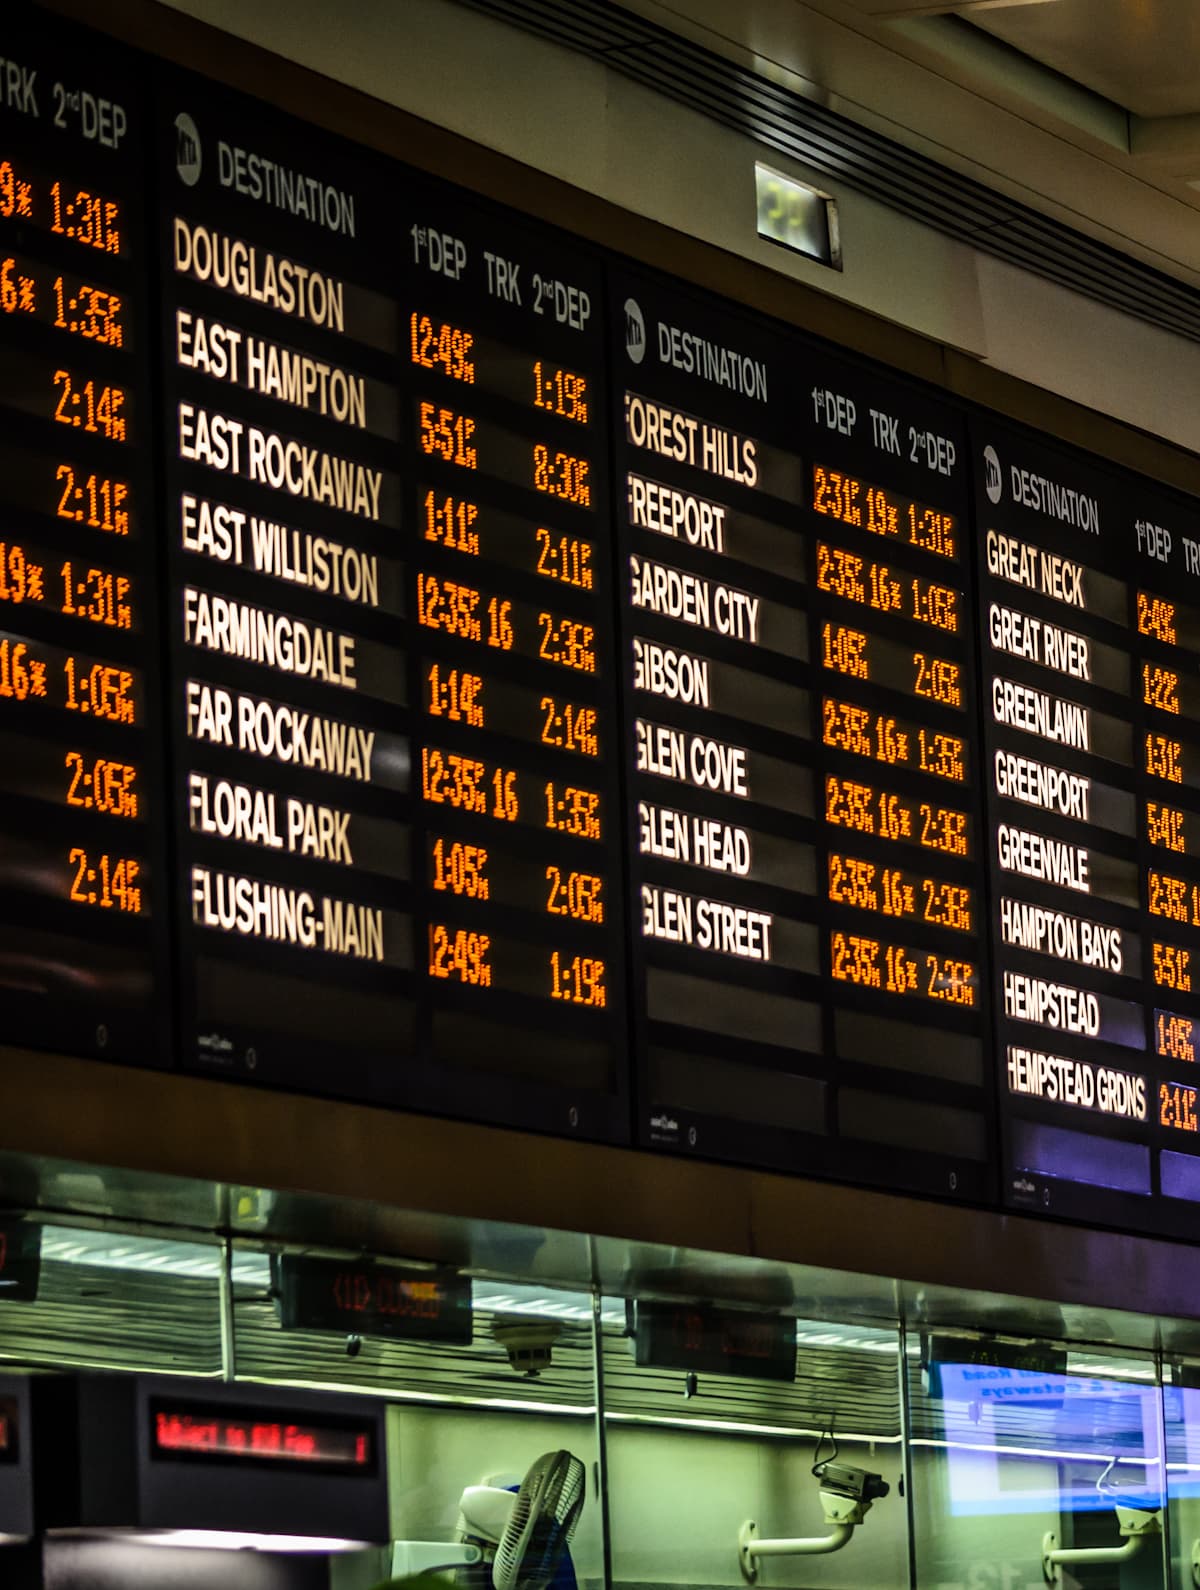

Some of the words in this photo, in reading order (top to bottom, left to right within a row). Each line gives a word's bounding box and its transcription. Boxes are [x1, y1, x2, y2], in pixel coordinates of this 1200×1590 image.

[218, 141, 355, 237] DESTINATION
[484, 251, 522, 306] TRK
[174, 217, 344, 332] DOUGLASTON
[177, 308, 242, 383] EAST
[248, 337, 366, 429] HAMPTON
[658, 321, 767, 403] DESTINATION
[869, 408, 901, 456] TRK
[178, 403, 244, 473] EAST
[248, 428, 382, 521] ROCKAWAY
[625, 395, 699, 466] OREST
[702, 423, 758, 488] HILLS
[628, 474, 726, 554] REEPORT
[1011, 465, 1099, 536] DESTINATION
[182, 492, 246, 563] EAST
[251, 518, 378, 606] WILLISTON
[487, 596, 514, 651] 16
[986, 529, 1037, 589] GREAT
[1040, 550, 1085, 608] NECK
[184, 586, 357, 689] FARMINGDALE
[714, 585, 760, 644] CITY
[989, 604, 1041, 661] GREAT
[1044, 625, 1090, 681] RIVER
[186, 680, 233, 746] FAR
[238, 695, 375, 782] ROCKAWAY
[492, 768, 519, 822] 16
[992, 677, 1089, 751] GREENLAWN
[690, 738, 748, 797] COVE
[994, 751, 1090, 820] GREENPORT
[189, 773, 283, 848] FLORAL
[288, 798, 353, 865] PARK
[695, 818, 751, 876] HEAD
[998, 825, 1089, 894] GREENVALE
[192, 867, 384, 963] FLUSHING-MAIN
[697, 900, 772, 961] STREET
[1001, 897, 1079, 961] HAMPTON
[1082, 921, 1122, 974] BAYS
[1003, 970, 1100, 1037] HEMPSTEAD
[1007, 1045, 1094, 1106] HEMPSTEAD
[1097, 1066, 1147, 1121] GRDNS
